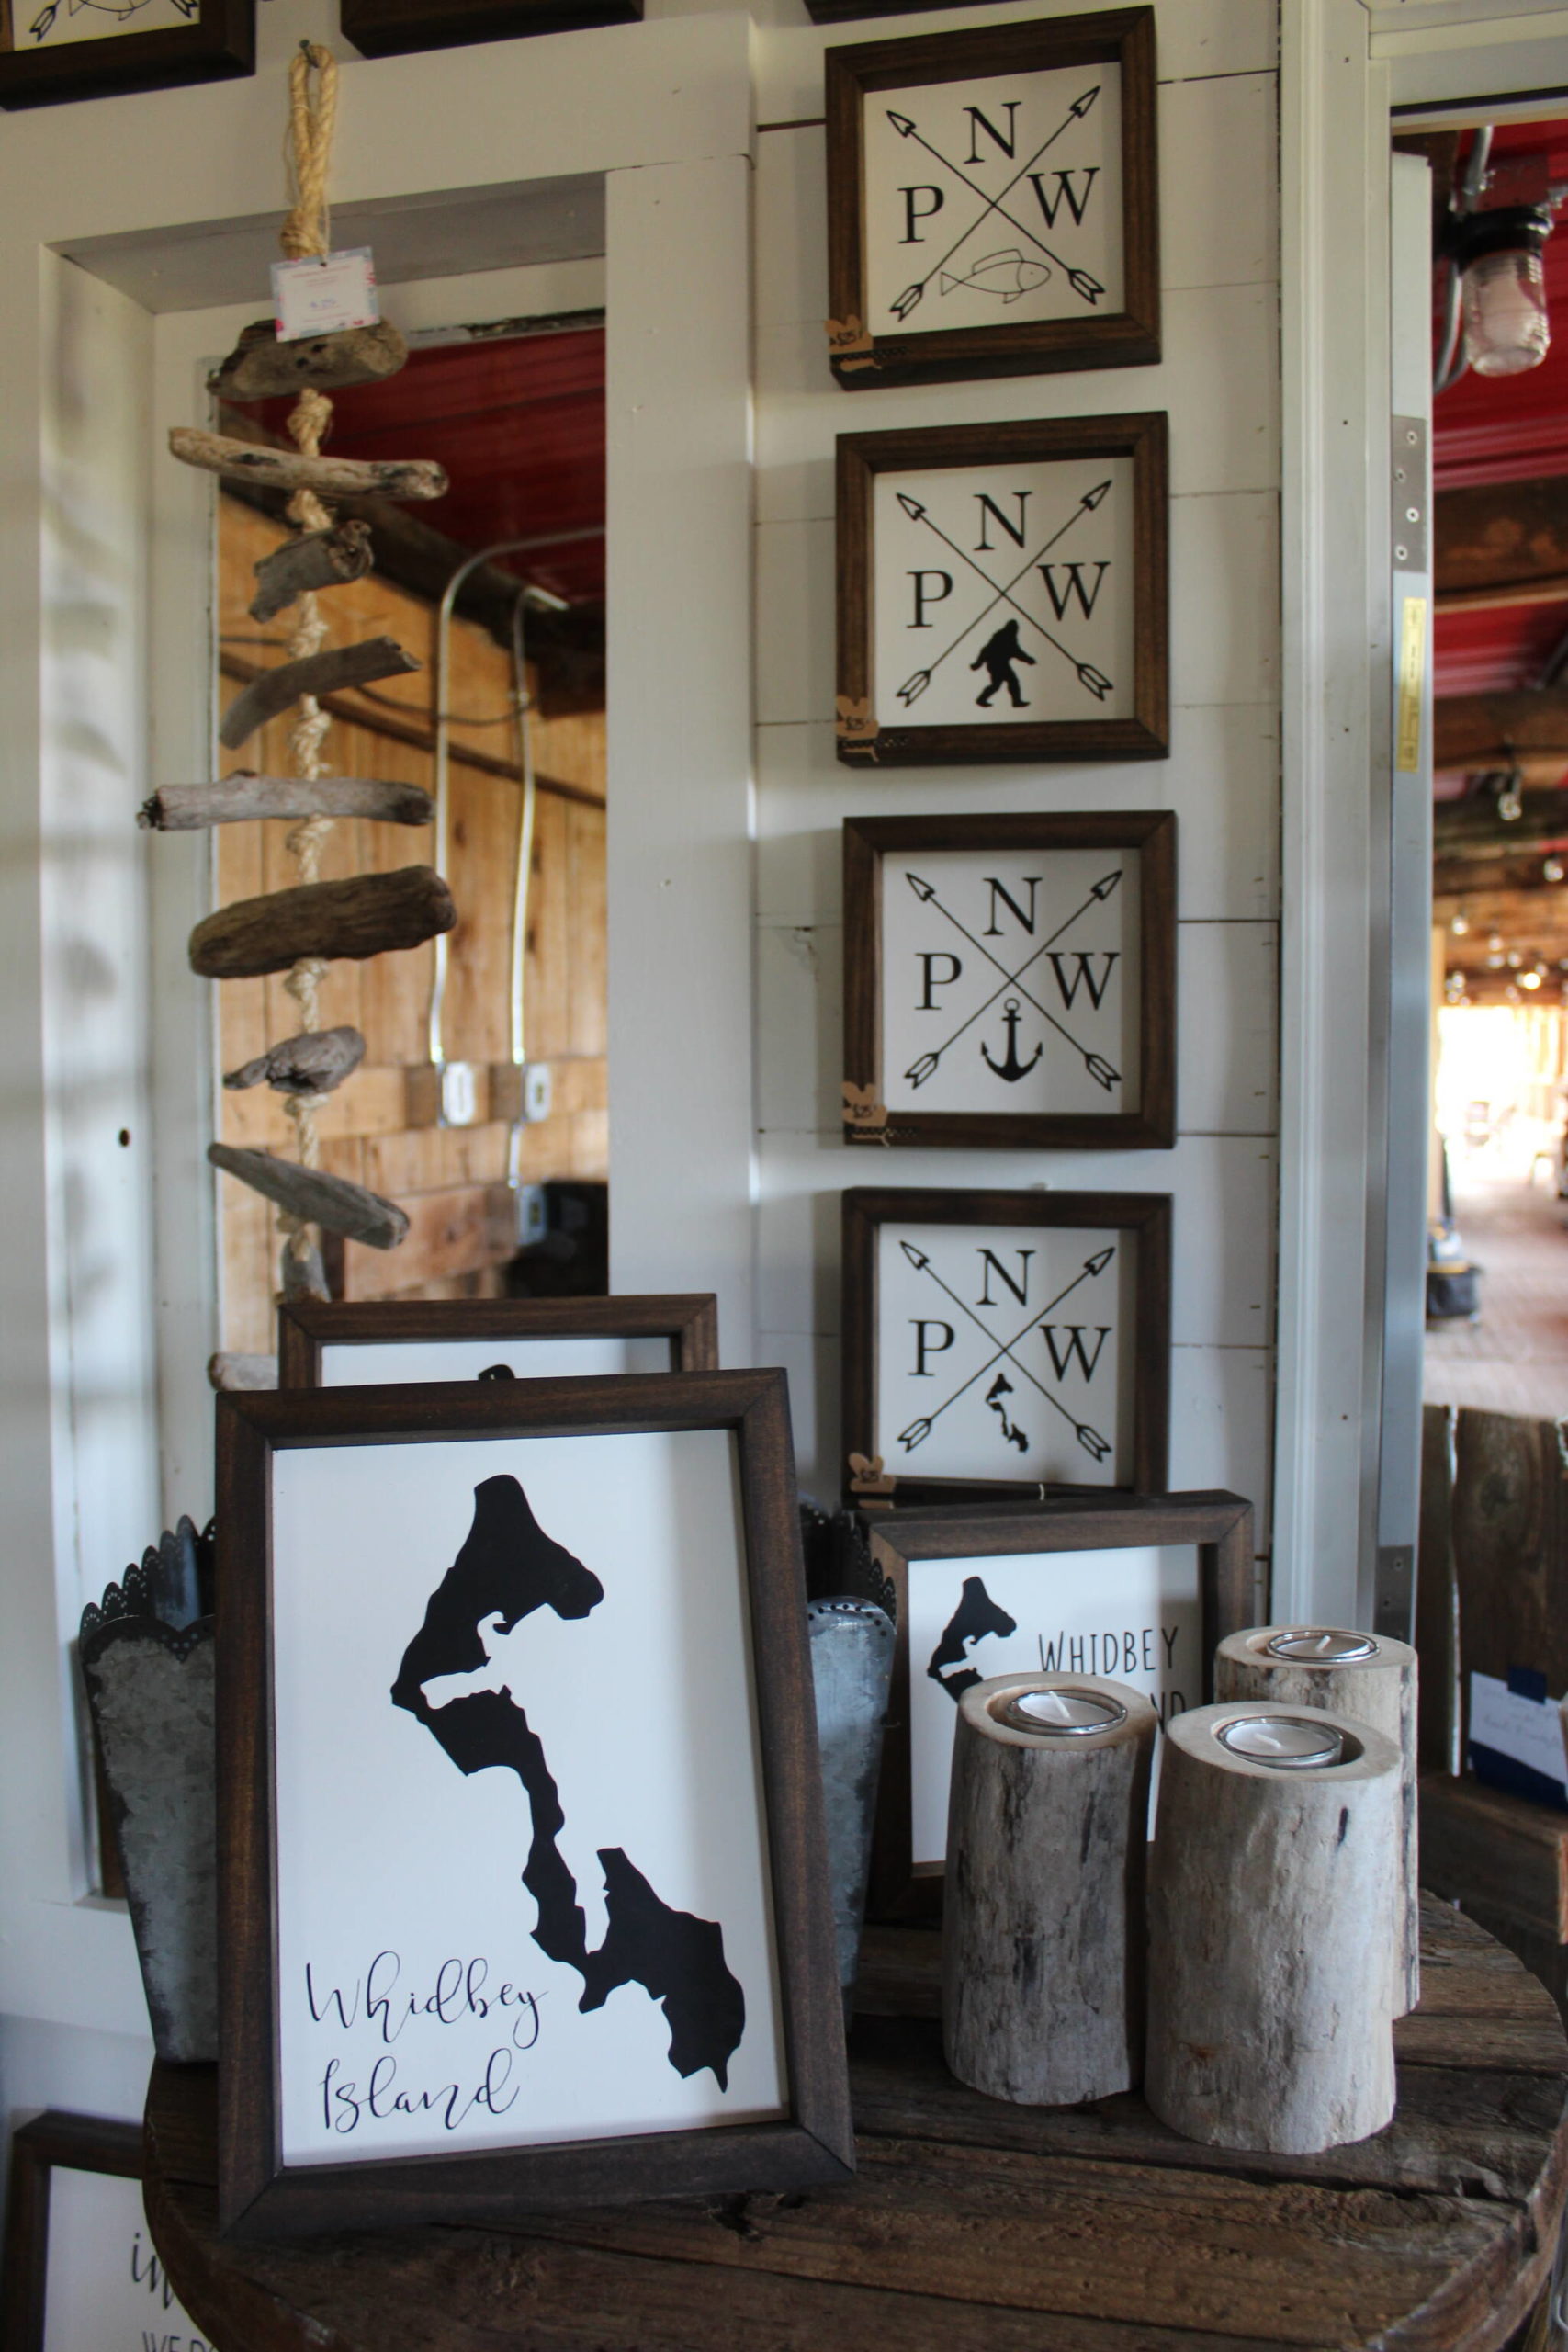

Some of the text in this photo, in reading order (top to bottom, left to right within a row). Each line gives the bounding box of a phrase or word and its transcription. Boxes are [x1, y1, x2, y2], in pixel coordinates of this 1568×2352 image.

[963, 101, 1021, 164] N
[897, 167, 1100, 244] P W
[973, 491, 1033, 551] N
[906, 561, 1111, 628] P W
[982, 876, 1043, 935] N
[915, 952, 1122, 1011] P W
[976, 1248, 1036, 1307] N
[908, 1319, 1113, 1384] P W
[1038, 1625, 1179, 1675] WHIDBEY
[306, 1950, 549, 2050] Whidbey
[318, 2047, 521, 2134] Island
